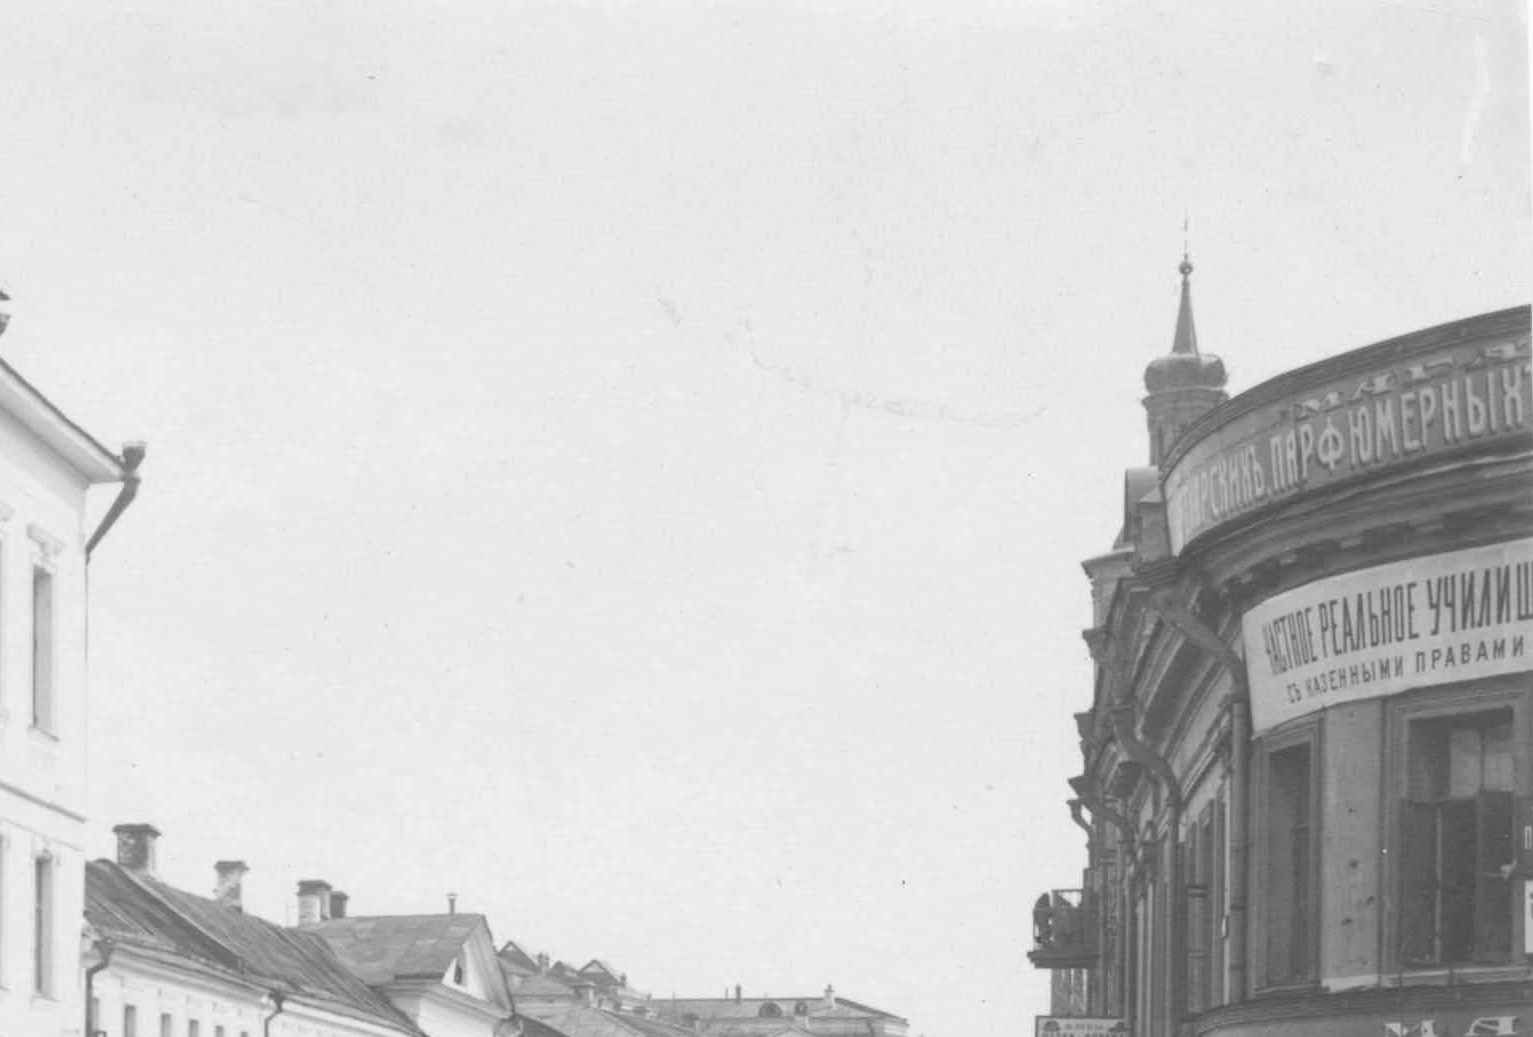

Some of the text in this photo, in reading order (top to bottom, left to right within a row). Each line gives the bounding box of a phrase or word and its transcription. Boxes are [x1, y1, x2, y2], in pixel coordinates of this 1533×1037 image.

[1299, 336, 1531, 416] МАГА
[1270, 362, 1531, 492] ПАРФЮМЕРНЫХ
[1318, 581, 1420, 658] РЕАЛЬНОЕ
[1285, 635, 1524, 704] СЪ КАЗЕННЫМИ ПРАВАМИ
